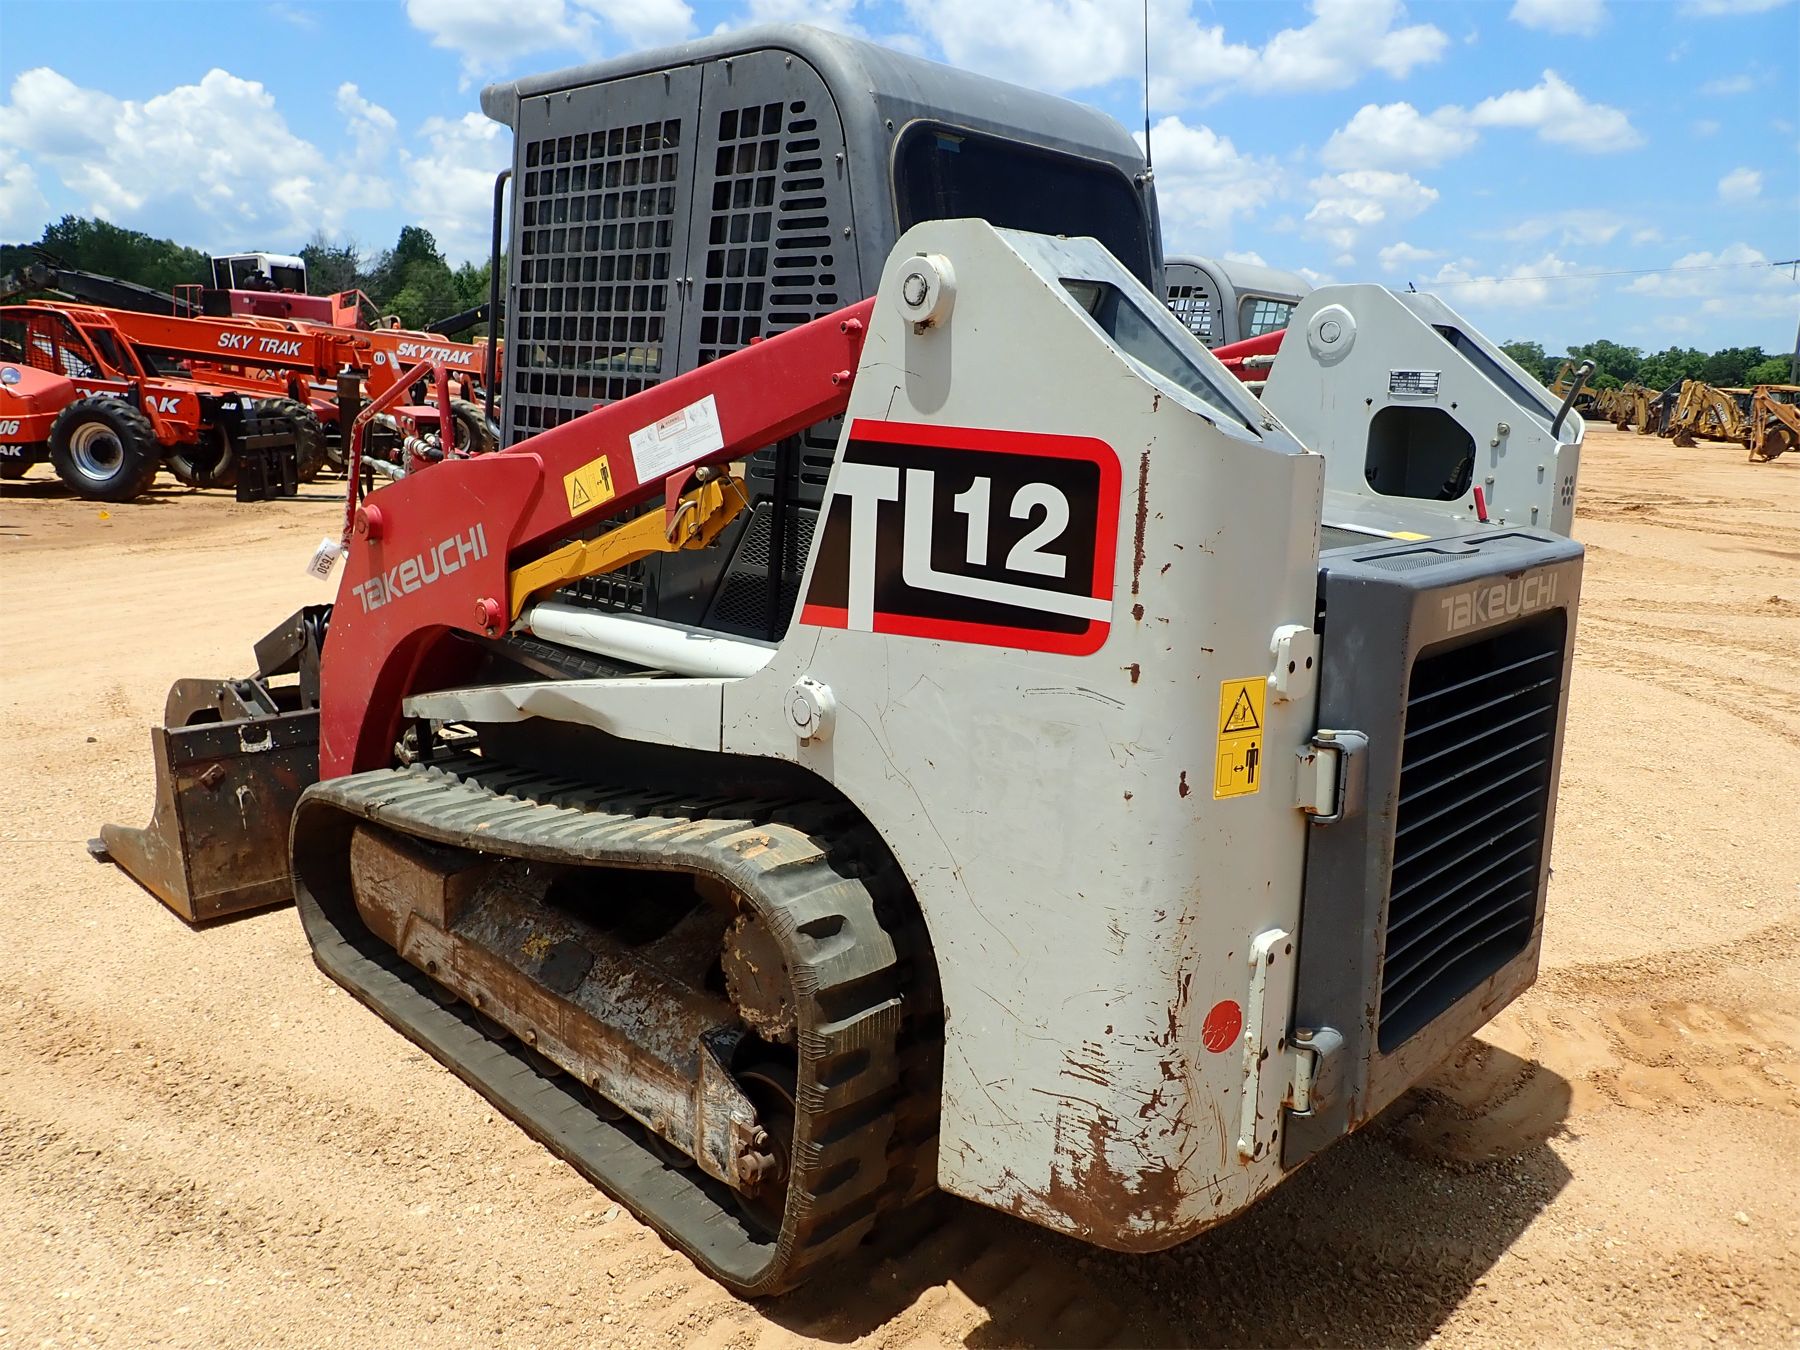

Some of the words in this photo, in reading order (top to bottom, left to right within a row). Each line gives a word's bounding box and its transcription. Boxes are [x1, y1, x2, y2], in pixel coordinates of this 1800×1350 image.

[217, 333, 253, 350] SKY
[259, 337, 302, 356] TRAK
[396, 343, 473, 365] SKYTRAK
[833, 461, 1113, 633] TL12
[316, 553, 335, 574] 7630
